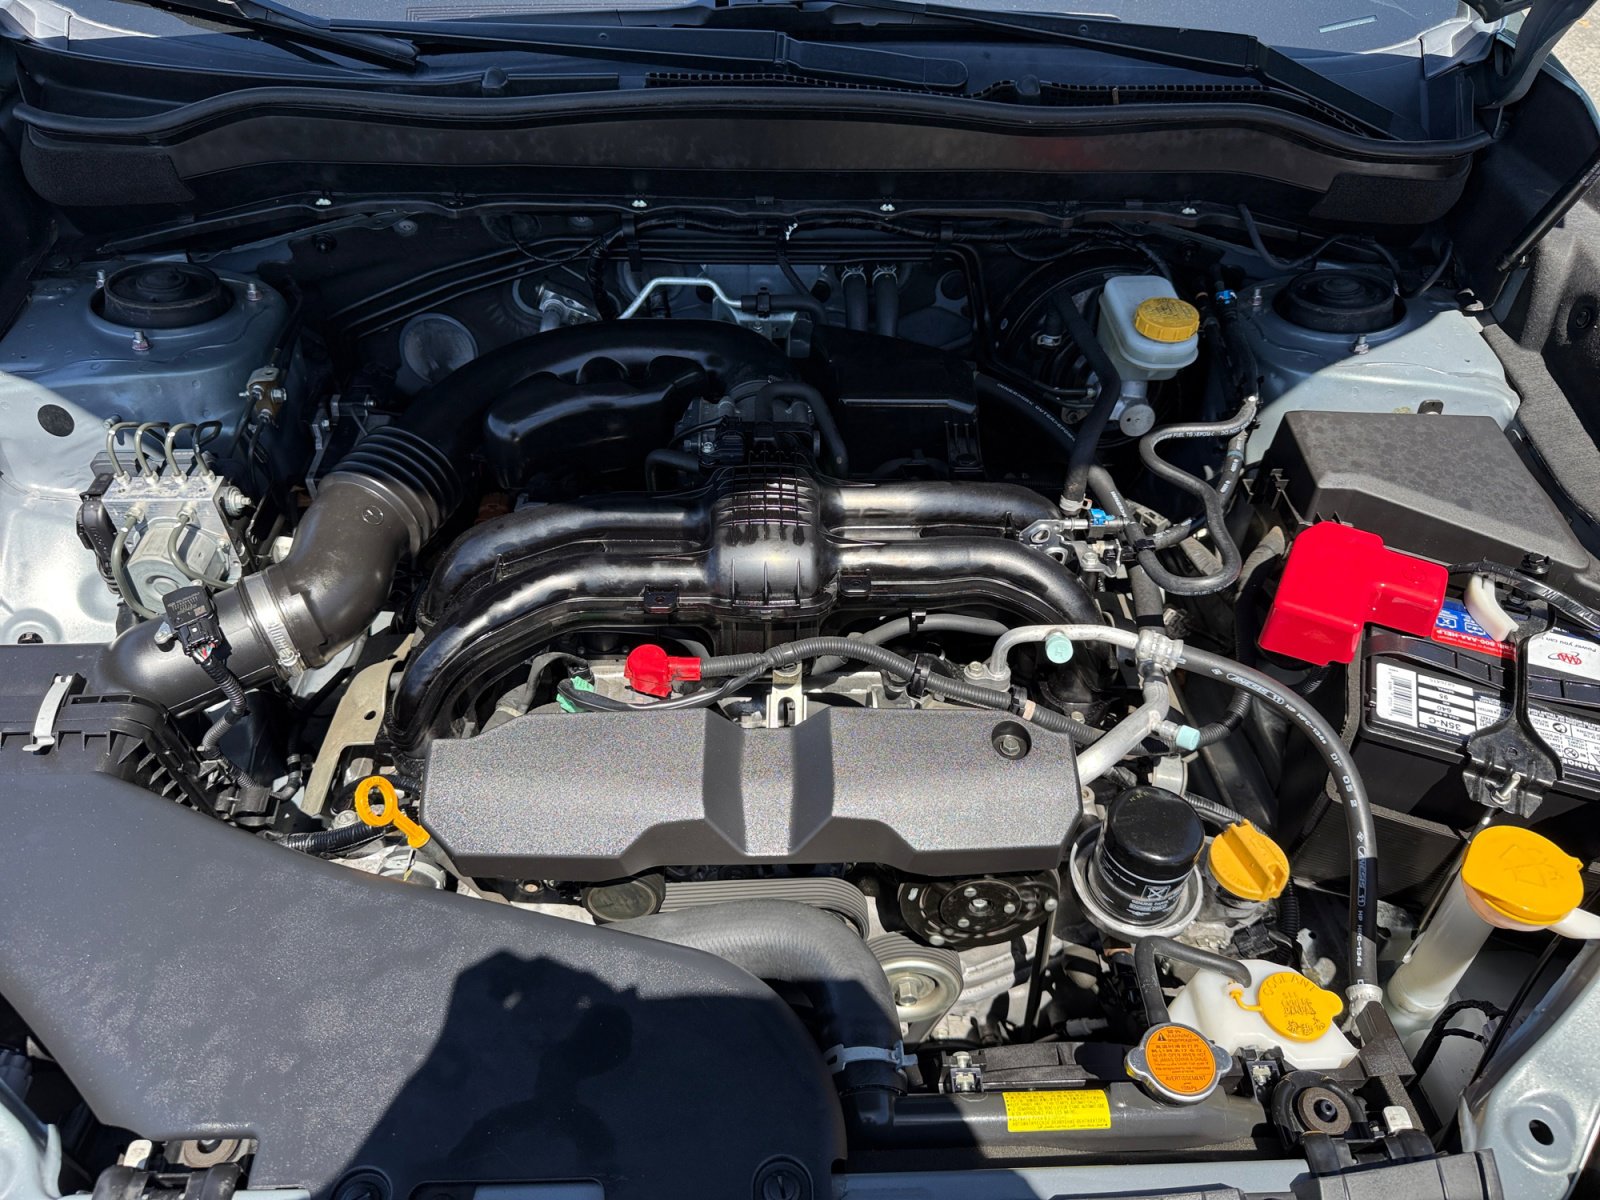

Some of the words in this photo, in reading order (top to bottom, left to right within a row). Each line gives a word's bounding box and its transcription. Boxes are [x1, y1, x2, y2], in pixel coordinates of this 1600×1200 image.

[1438, 692, 1449, 700] 95
[1435, 704, 1452, 713] 640
[1427, 716, 1461, 731] 35N-C
